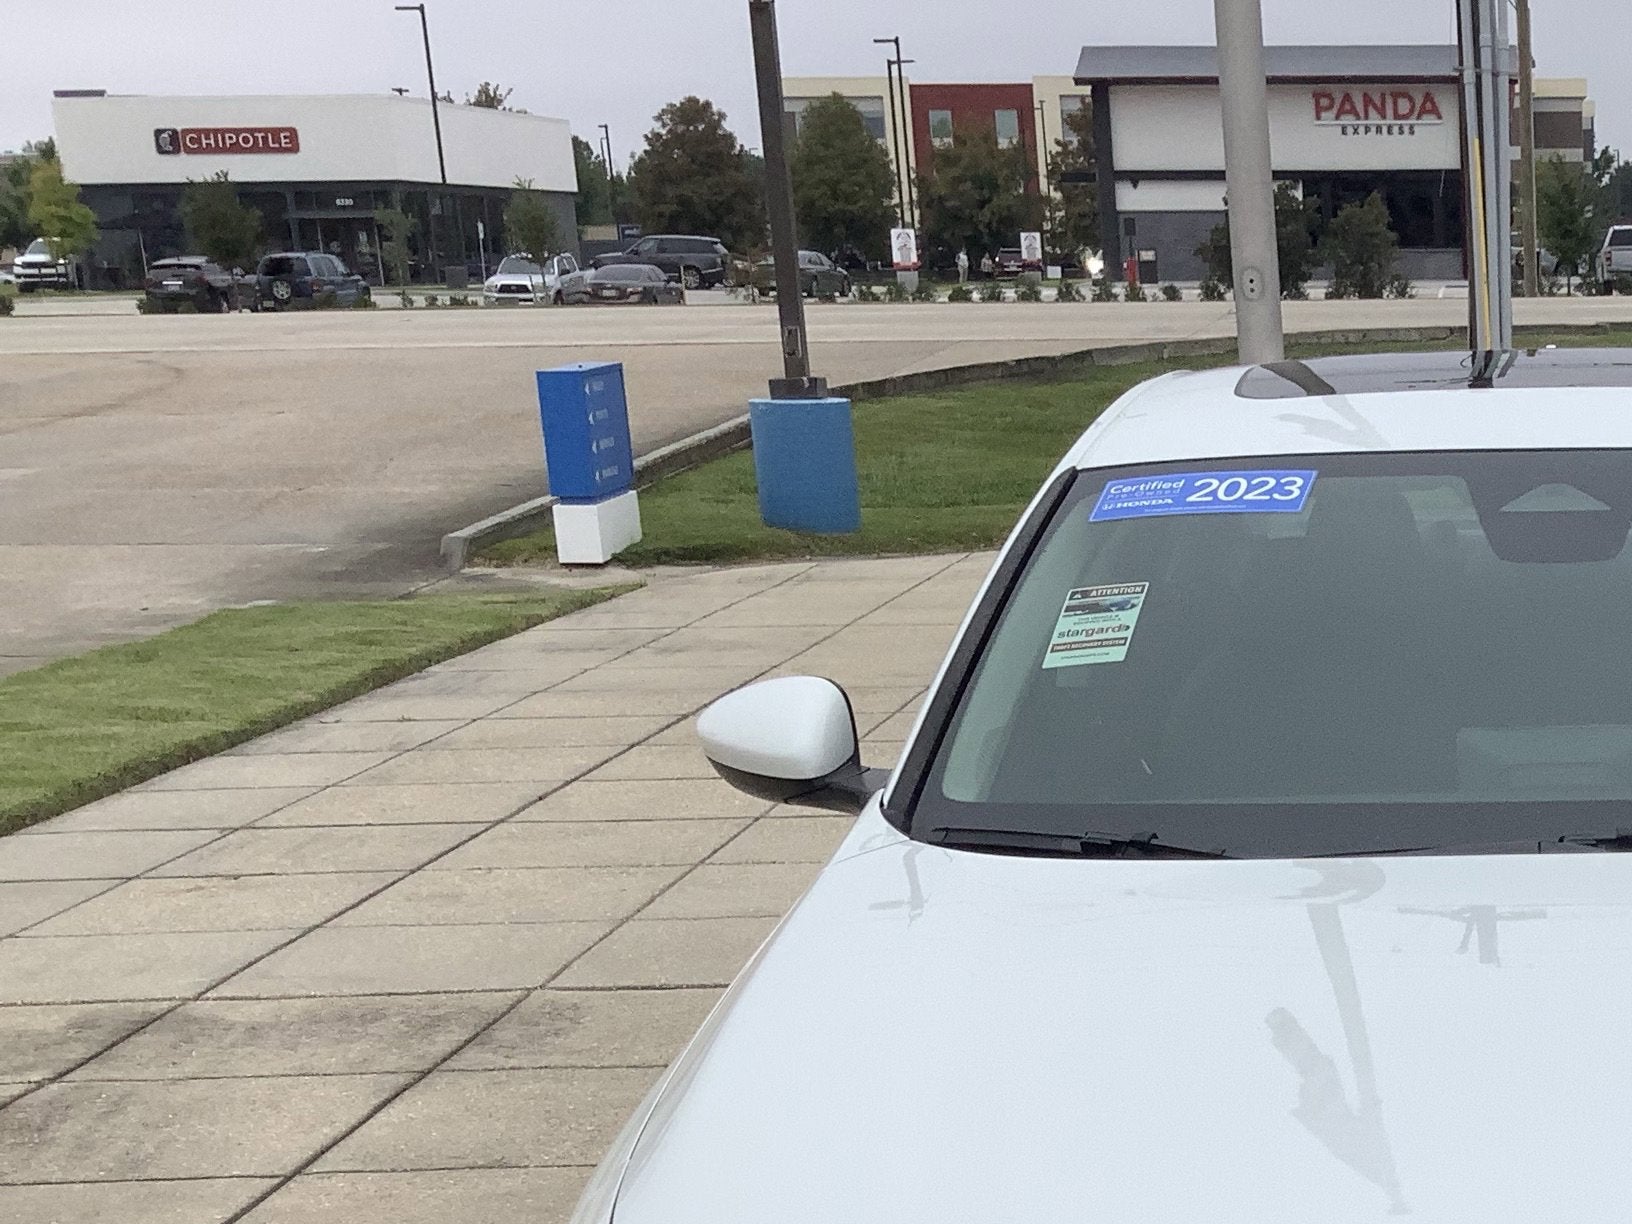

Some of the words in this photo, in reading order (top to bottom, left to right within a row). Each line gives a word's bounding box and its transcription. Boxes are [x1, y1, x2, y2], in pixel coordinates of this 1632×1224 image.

[1312, 91, 1443, 121] PANDA
[1341, 125, 1416, 136] EXPRESS
[185, 132, 293, 149] CHIPOTLE
[1110, 479, 1185, 494] Certified
[1185, 476, 1305, 502] 2023
[1115, 498, 1174, 509] HONDA
[1089, 586, 1143, 597] ATTENTION
